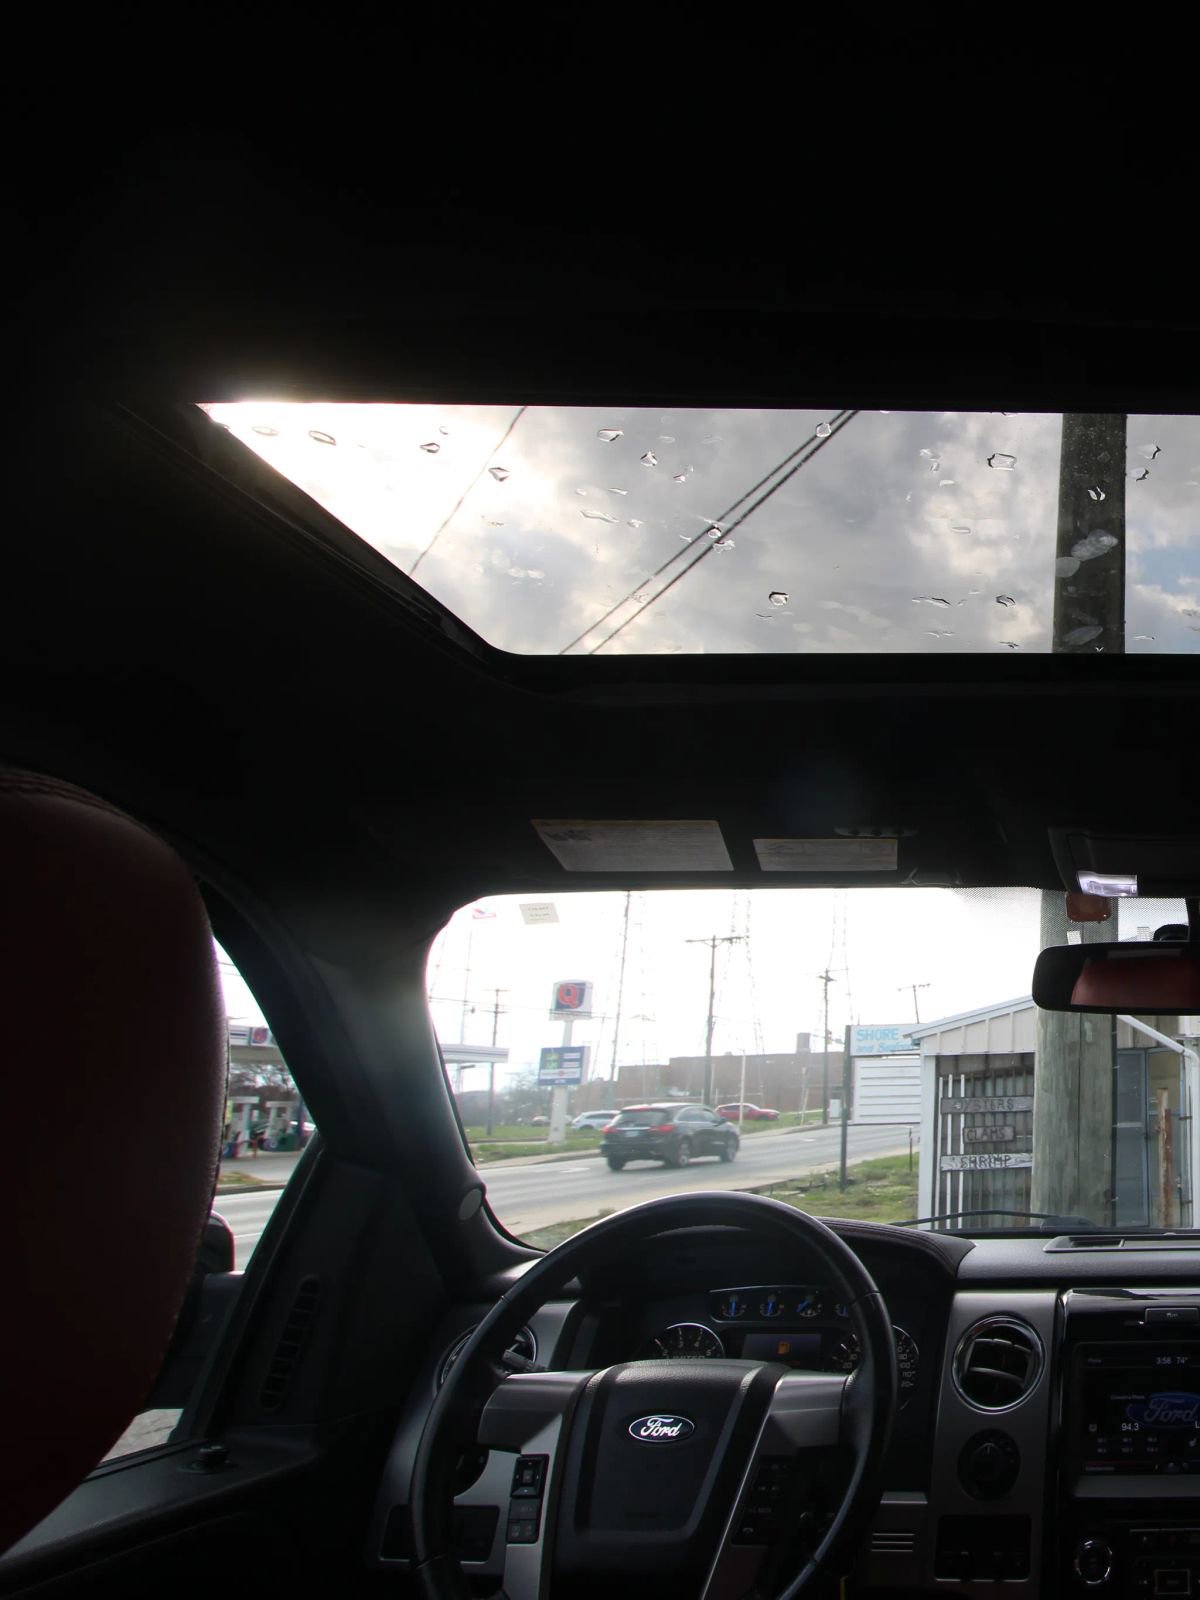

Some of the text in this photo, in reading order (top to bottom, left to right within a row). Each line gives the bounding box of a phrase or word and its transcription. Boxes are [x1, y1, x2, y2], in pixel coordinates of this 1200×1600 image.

[856, 1028, 899, 1041] SHORE
[966, 1127, 1006, 1141] CLAMS
[960, 1154, 1011, 1169] SHRIMP
[1143, 1397, 1200, 1423] Ford
[640, 1417, 683, 1437] Ford
[1121, 1422, 1140, 1432] 94.3
